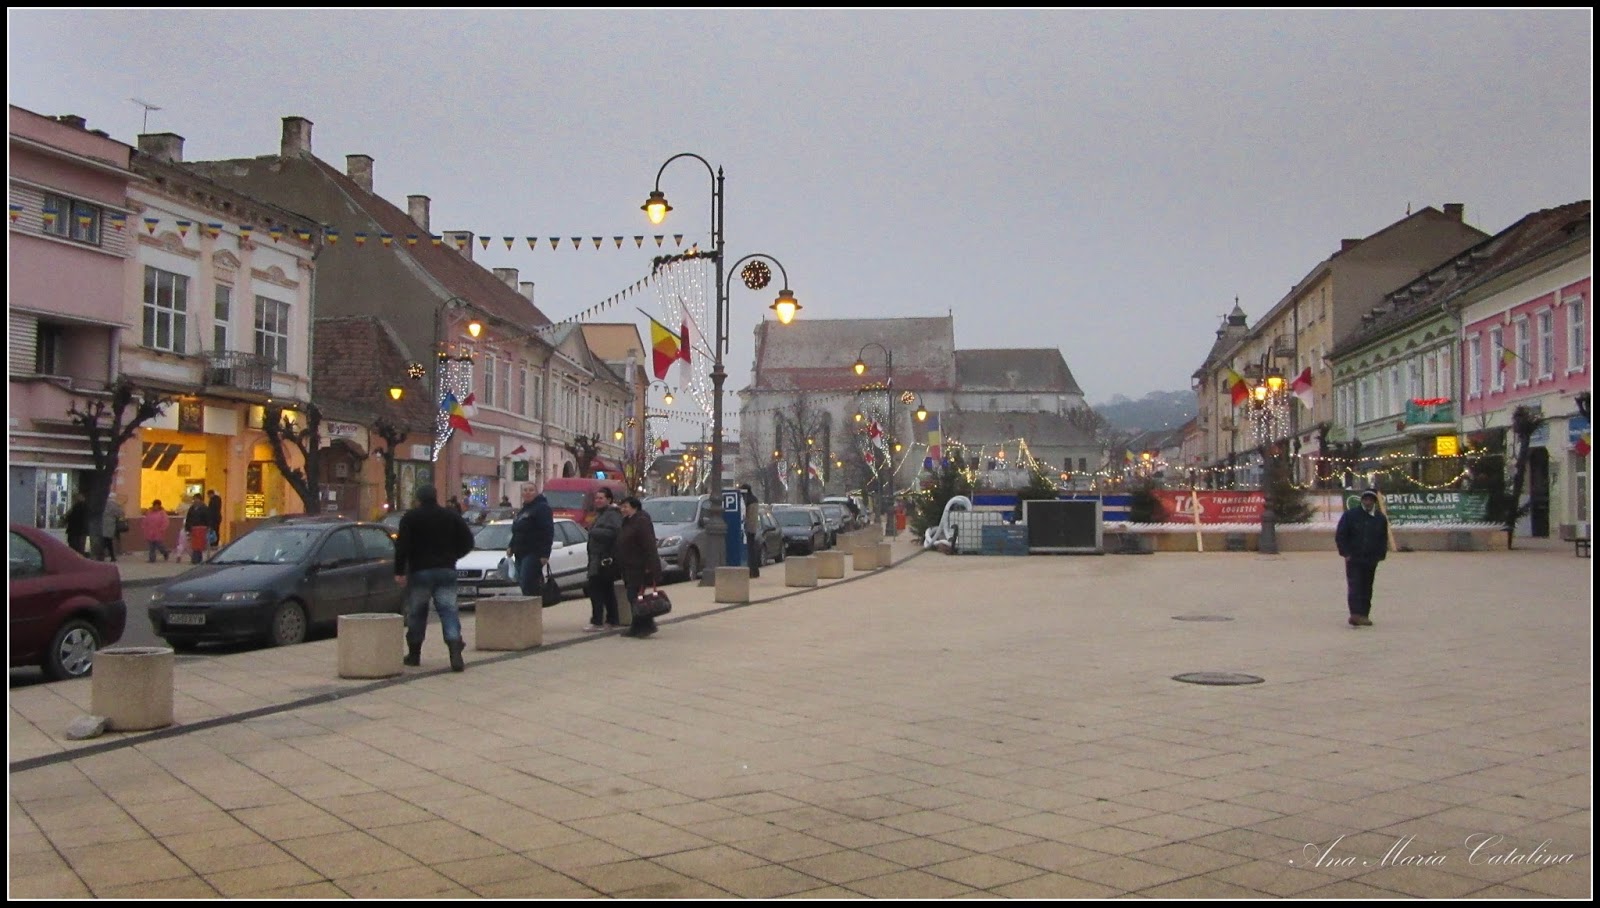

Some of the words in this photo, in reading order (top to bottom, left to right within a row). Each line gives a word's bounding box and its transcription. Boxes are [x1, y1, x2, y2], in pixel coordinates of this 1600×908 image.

[725, 496, 735, 508] P
[1426, 493, 1460, 503] CARE
[1221, 505, 1258, 514] LOGISTIC
